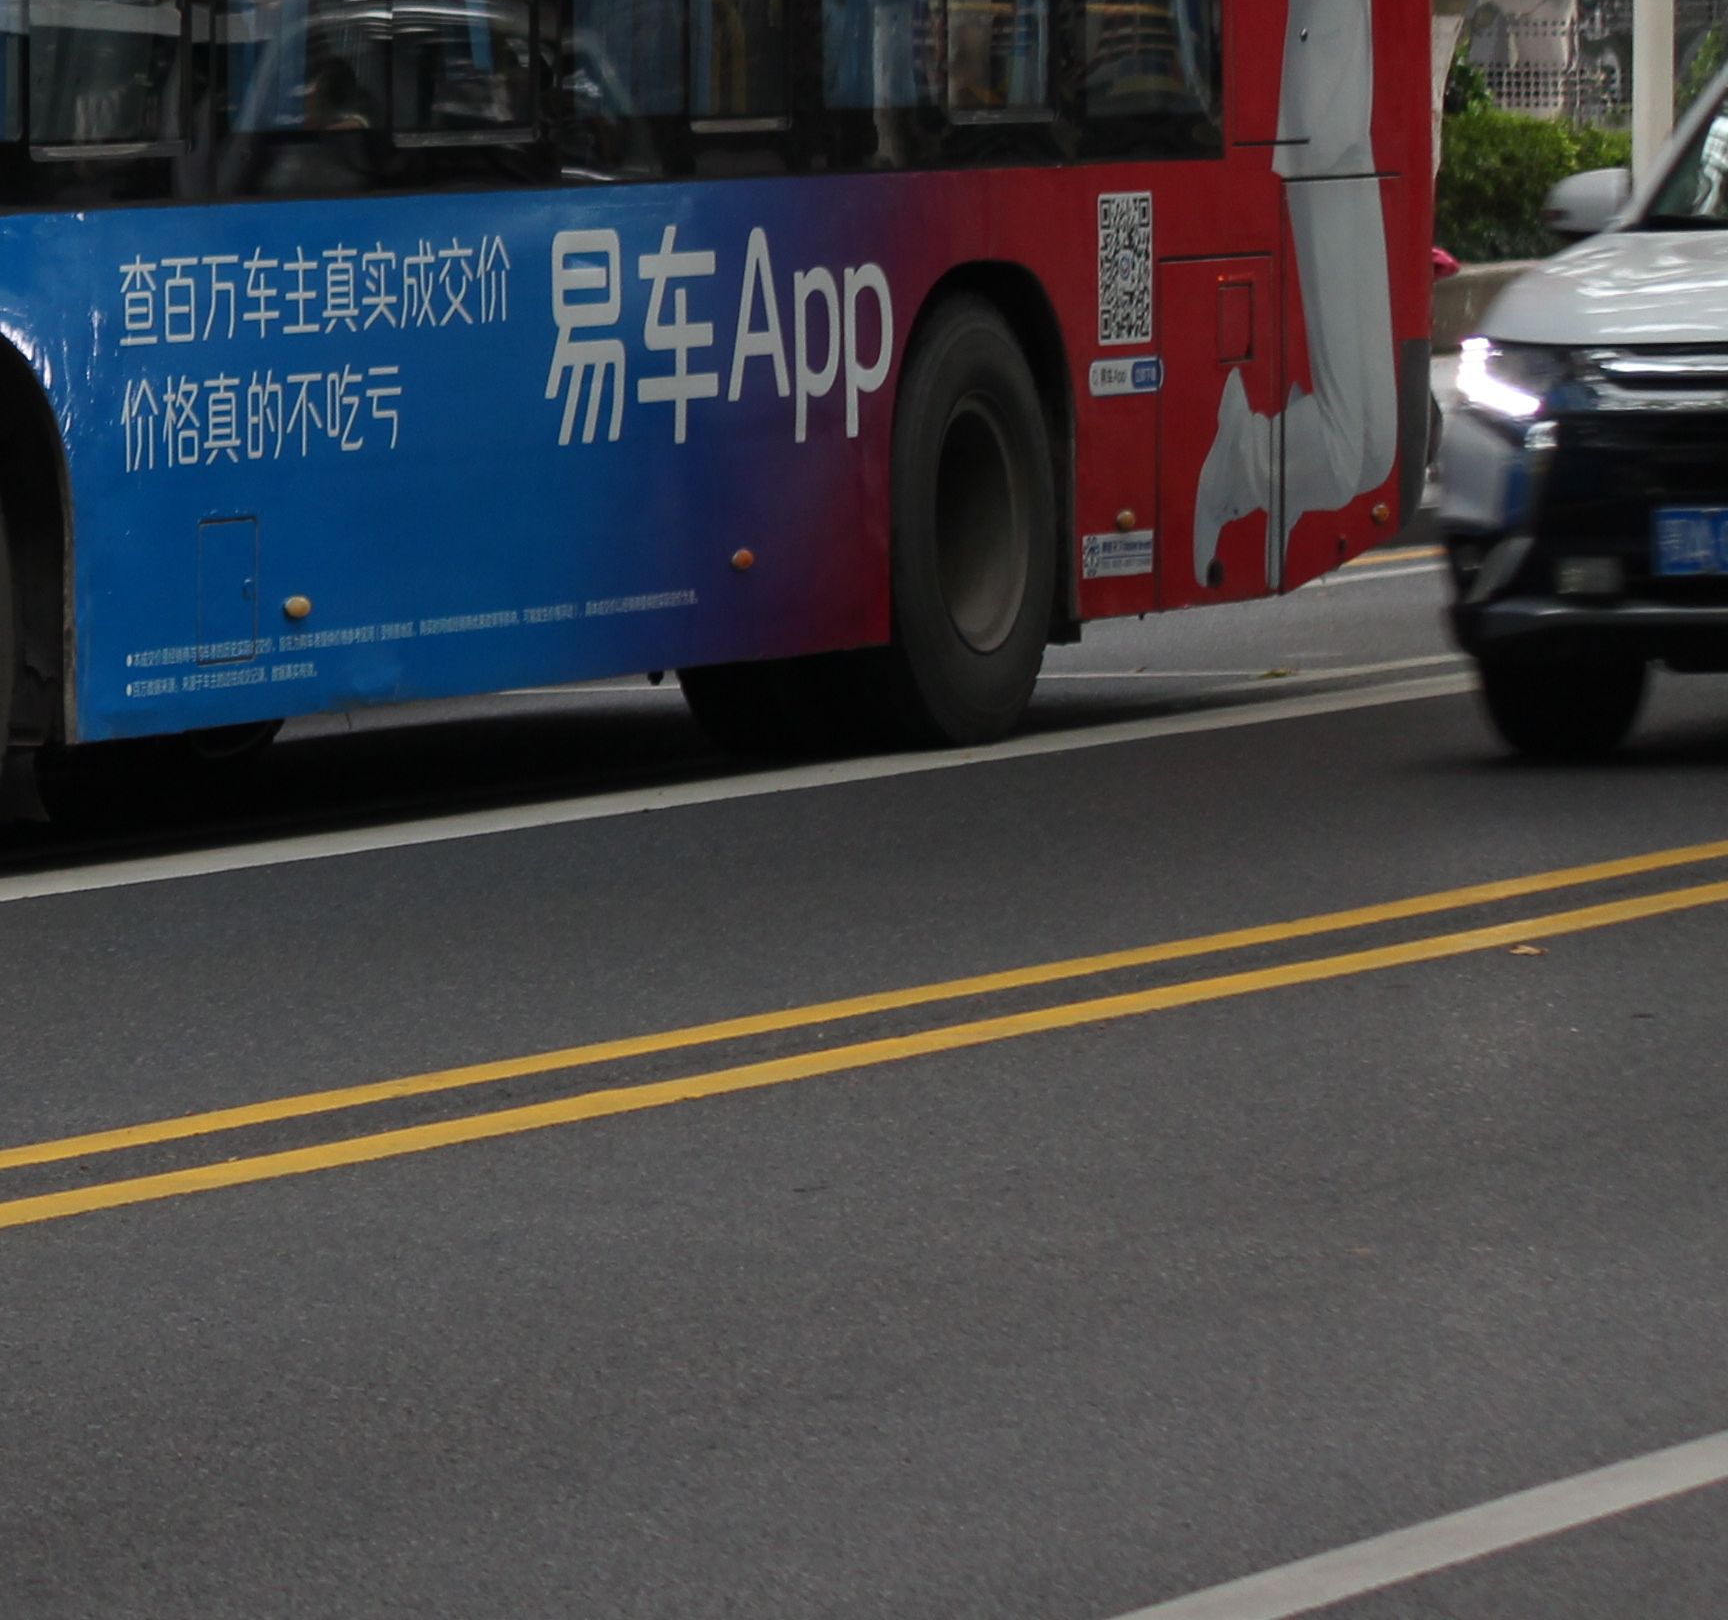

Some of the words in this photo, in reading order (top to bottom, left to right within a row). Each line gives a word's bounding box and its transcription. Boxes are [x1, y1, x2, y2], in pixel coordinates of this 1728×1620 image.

[119, 233, 511, 347] 查百万车主真实成交价
[544, 224, 894, 446] 易车App
[119, 362, 403, 472] 价格真的不吃亏
